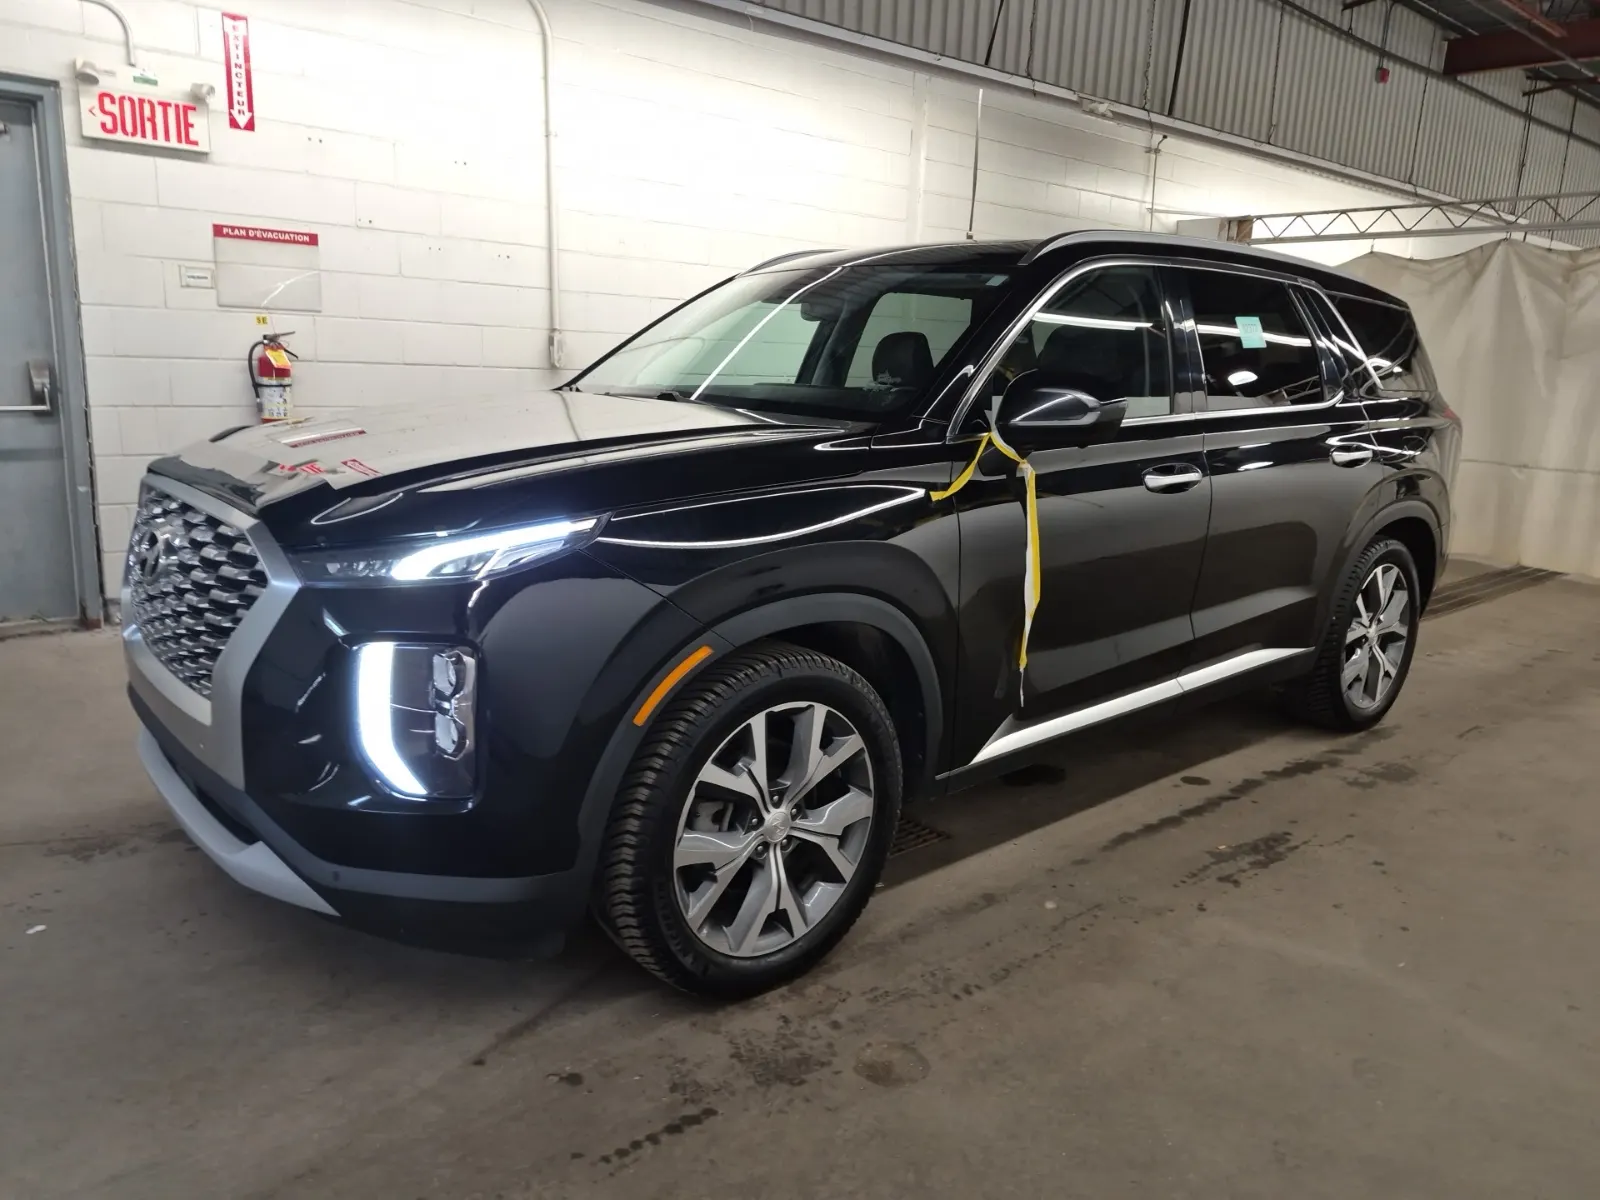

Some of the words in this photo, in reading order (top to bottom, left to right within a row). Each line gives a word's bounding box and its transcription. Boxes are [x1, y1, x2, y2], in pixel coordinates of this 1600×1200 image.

[231, 23, 246, 116] EXTINCTEUR
[98, 92, 199, 146] SORTIE
[222, 226, 247, 237] PLAN
[248, 228, 310, 243] D'ÉVACUATION
